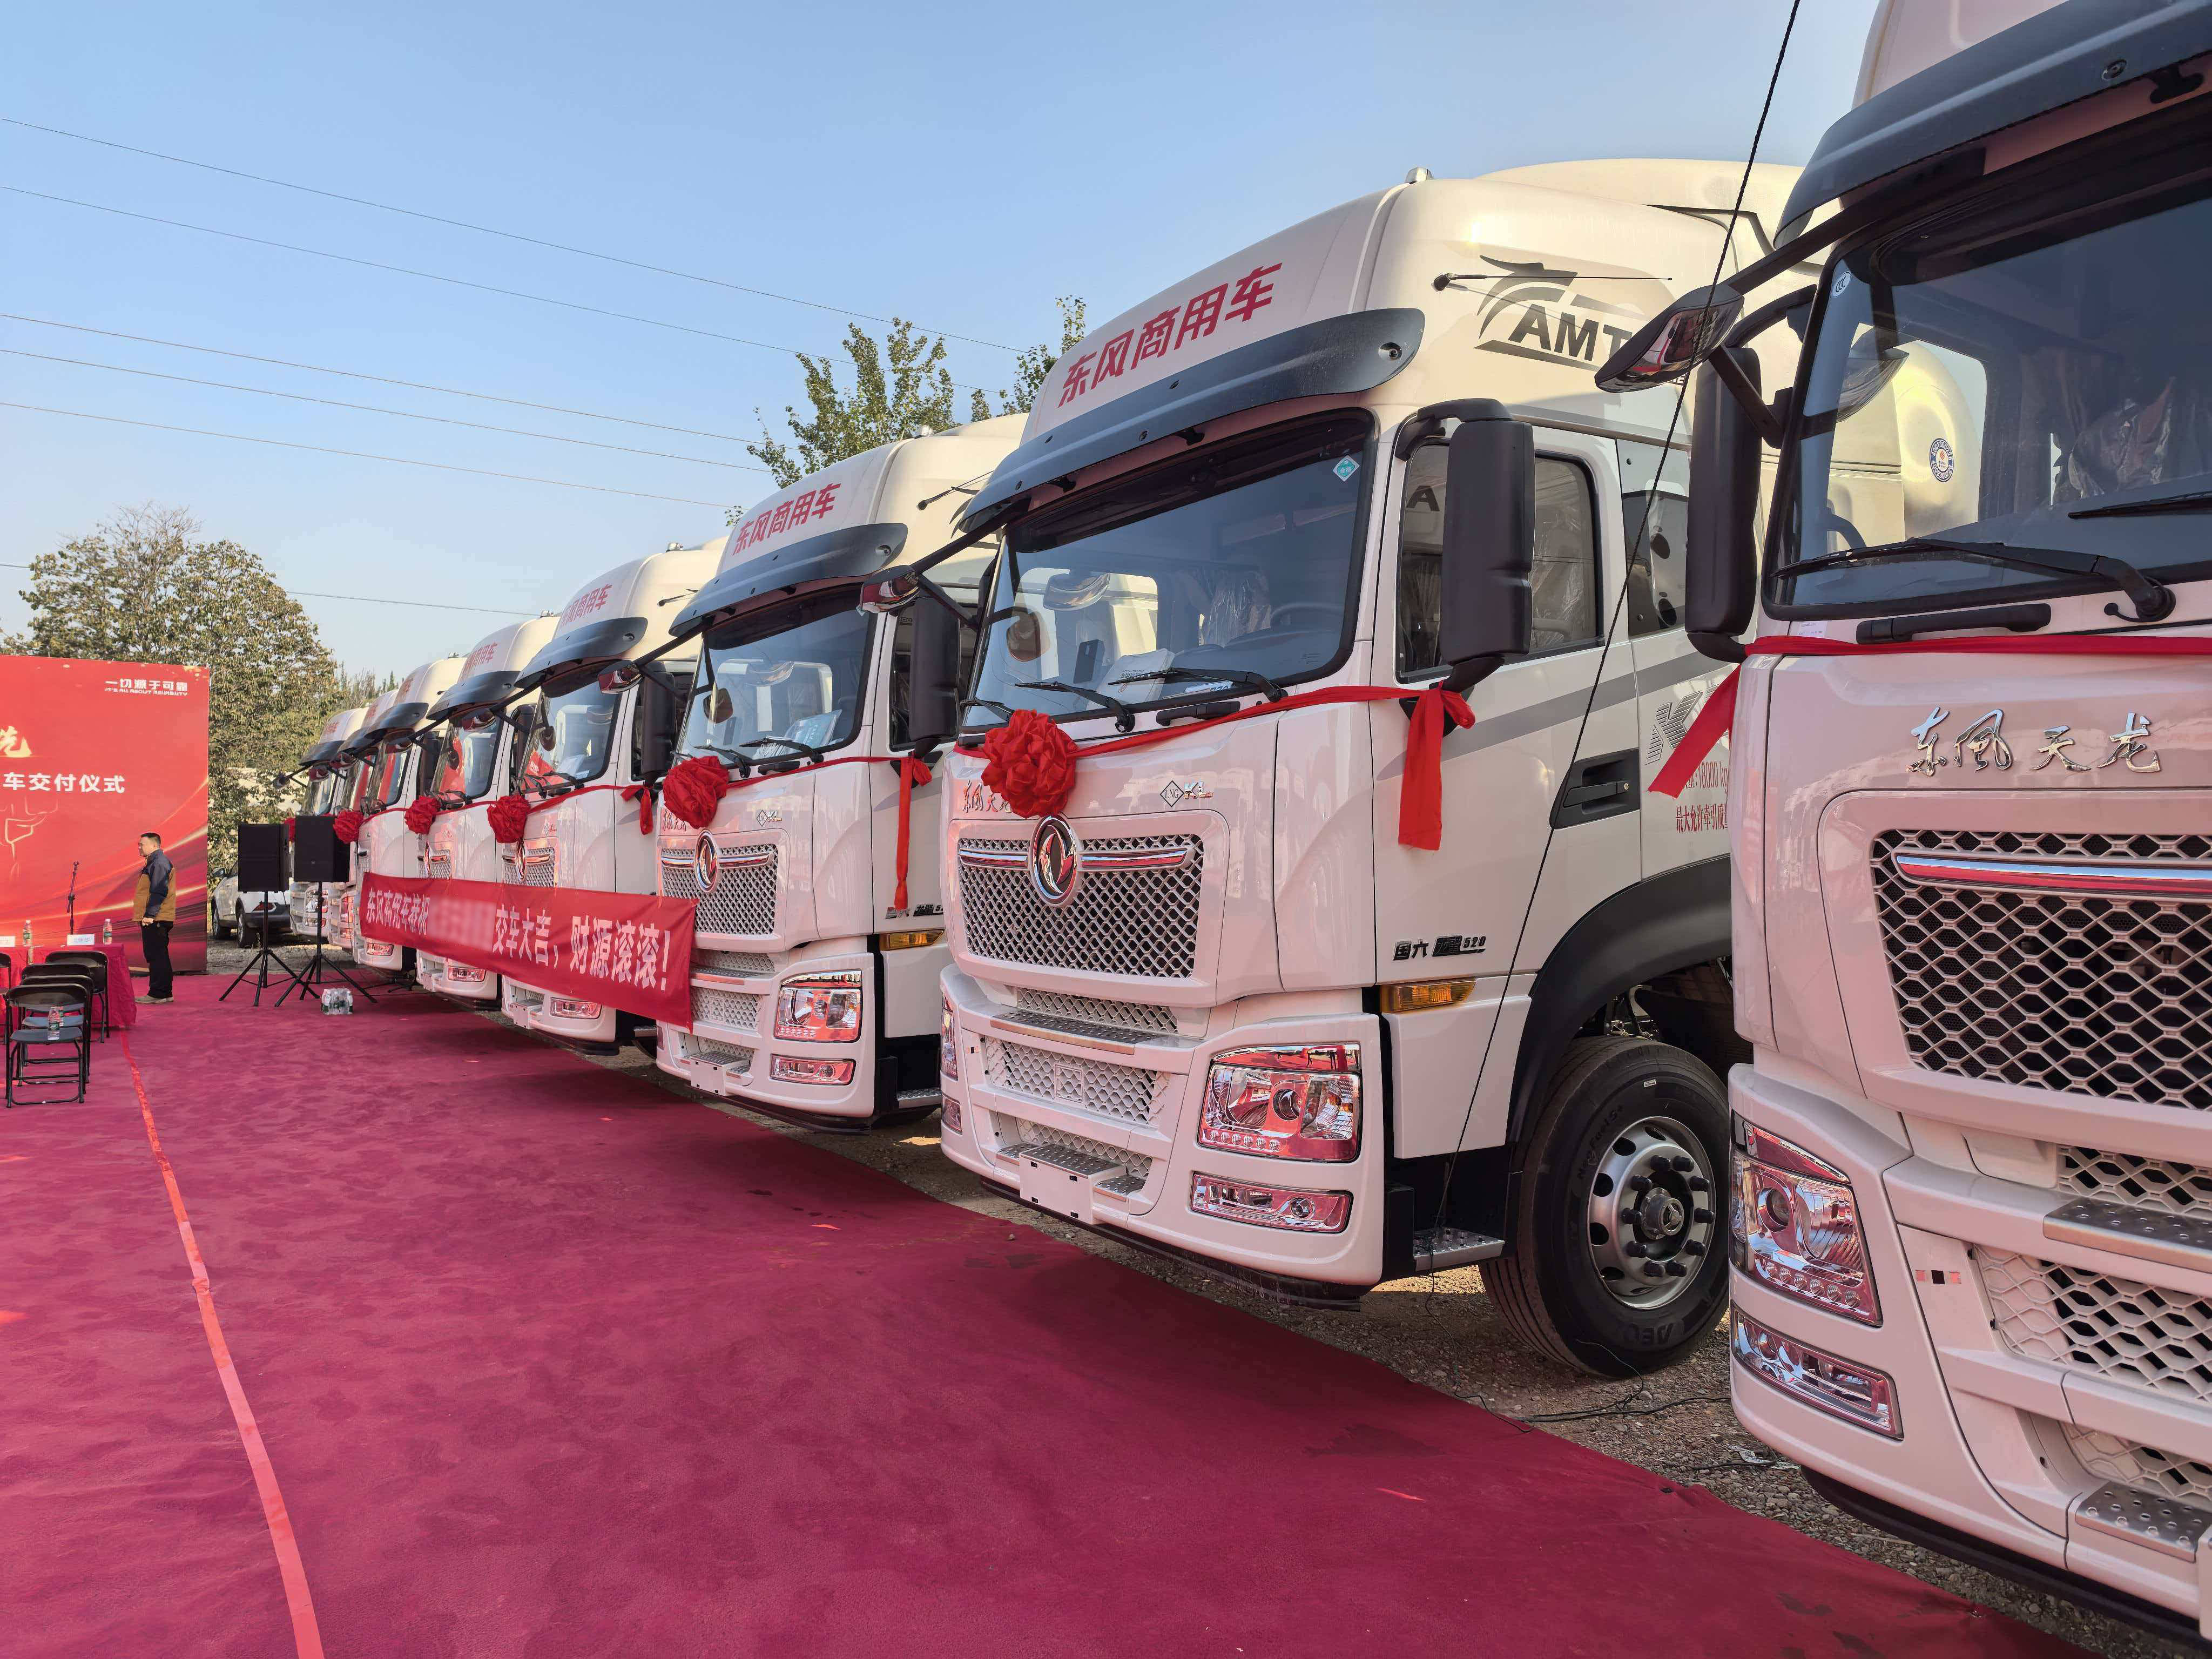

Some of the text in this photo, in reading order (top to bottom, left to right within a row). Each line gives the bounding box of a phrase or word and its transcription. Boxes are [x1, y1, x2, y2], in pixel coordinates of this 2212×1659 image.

[1058, 262, 1283, 408] 东风商用车
[1508, 304, 1633, 361] AMT
[732, 483, 841, 556] 东风商用车
[1906, 705, 2161, 777] 东风天龙
[3, 772, 126, 794] 车交付仪式
[1165, 788, 1179, 799] LNG
[1462, 936, 1486, 948] 520
